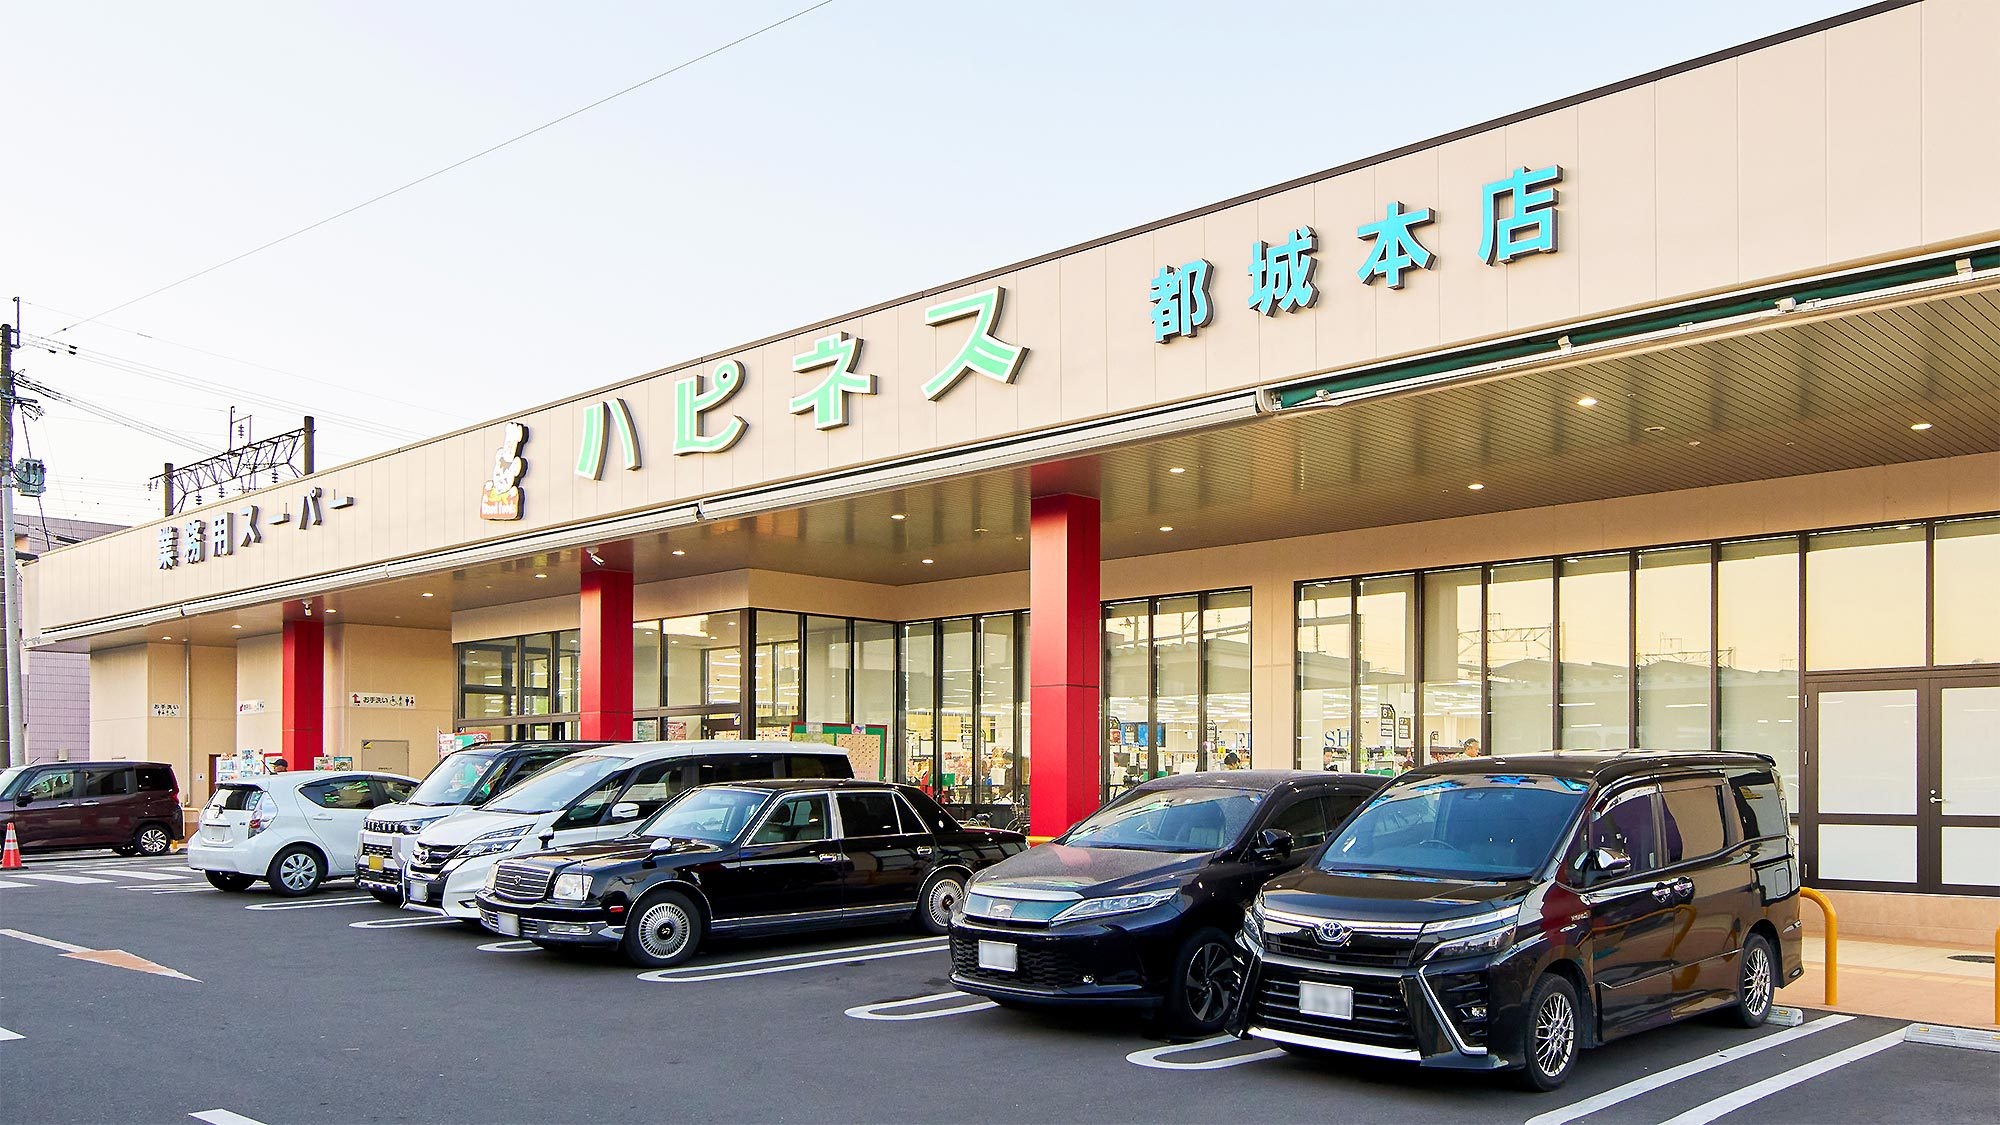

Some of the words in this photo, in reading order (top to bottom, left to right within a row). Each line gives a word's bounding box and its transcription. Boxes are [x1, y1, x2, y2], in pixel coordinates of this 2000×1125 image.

[1148, 164, 1562, 344] 都城本店
[575, 286, 1029, 480] ハピネス
[157, 487, 354, 570] 業務用スーパー
